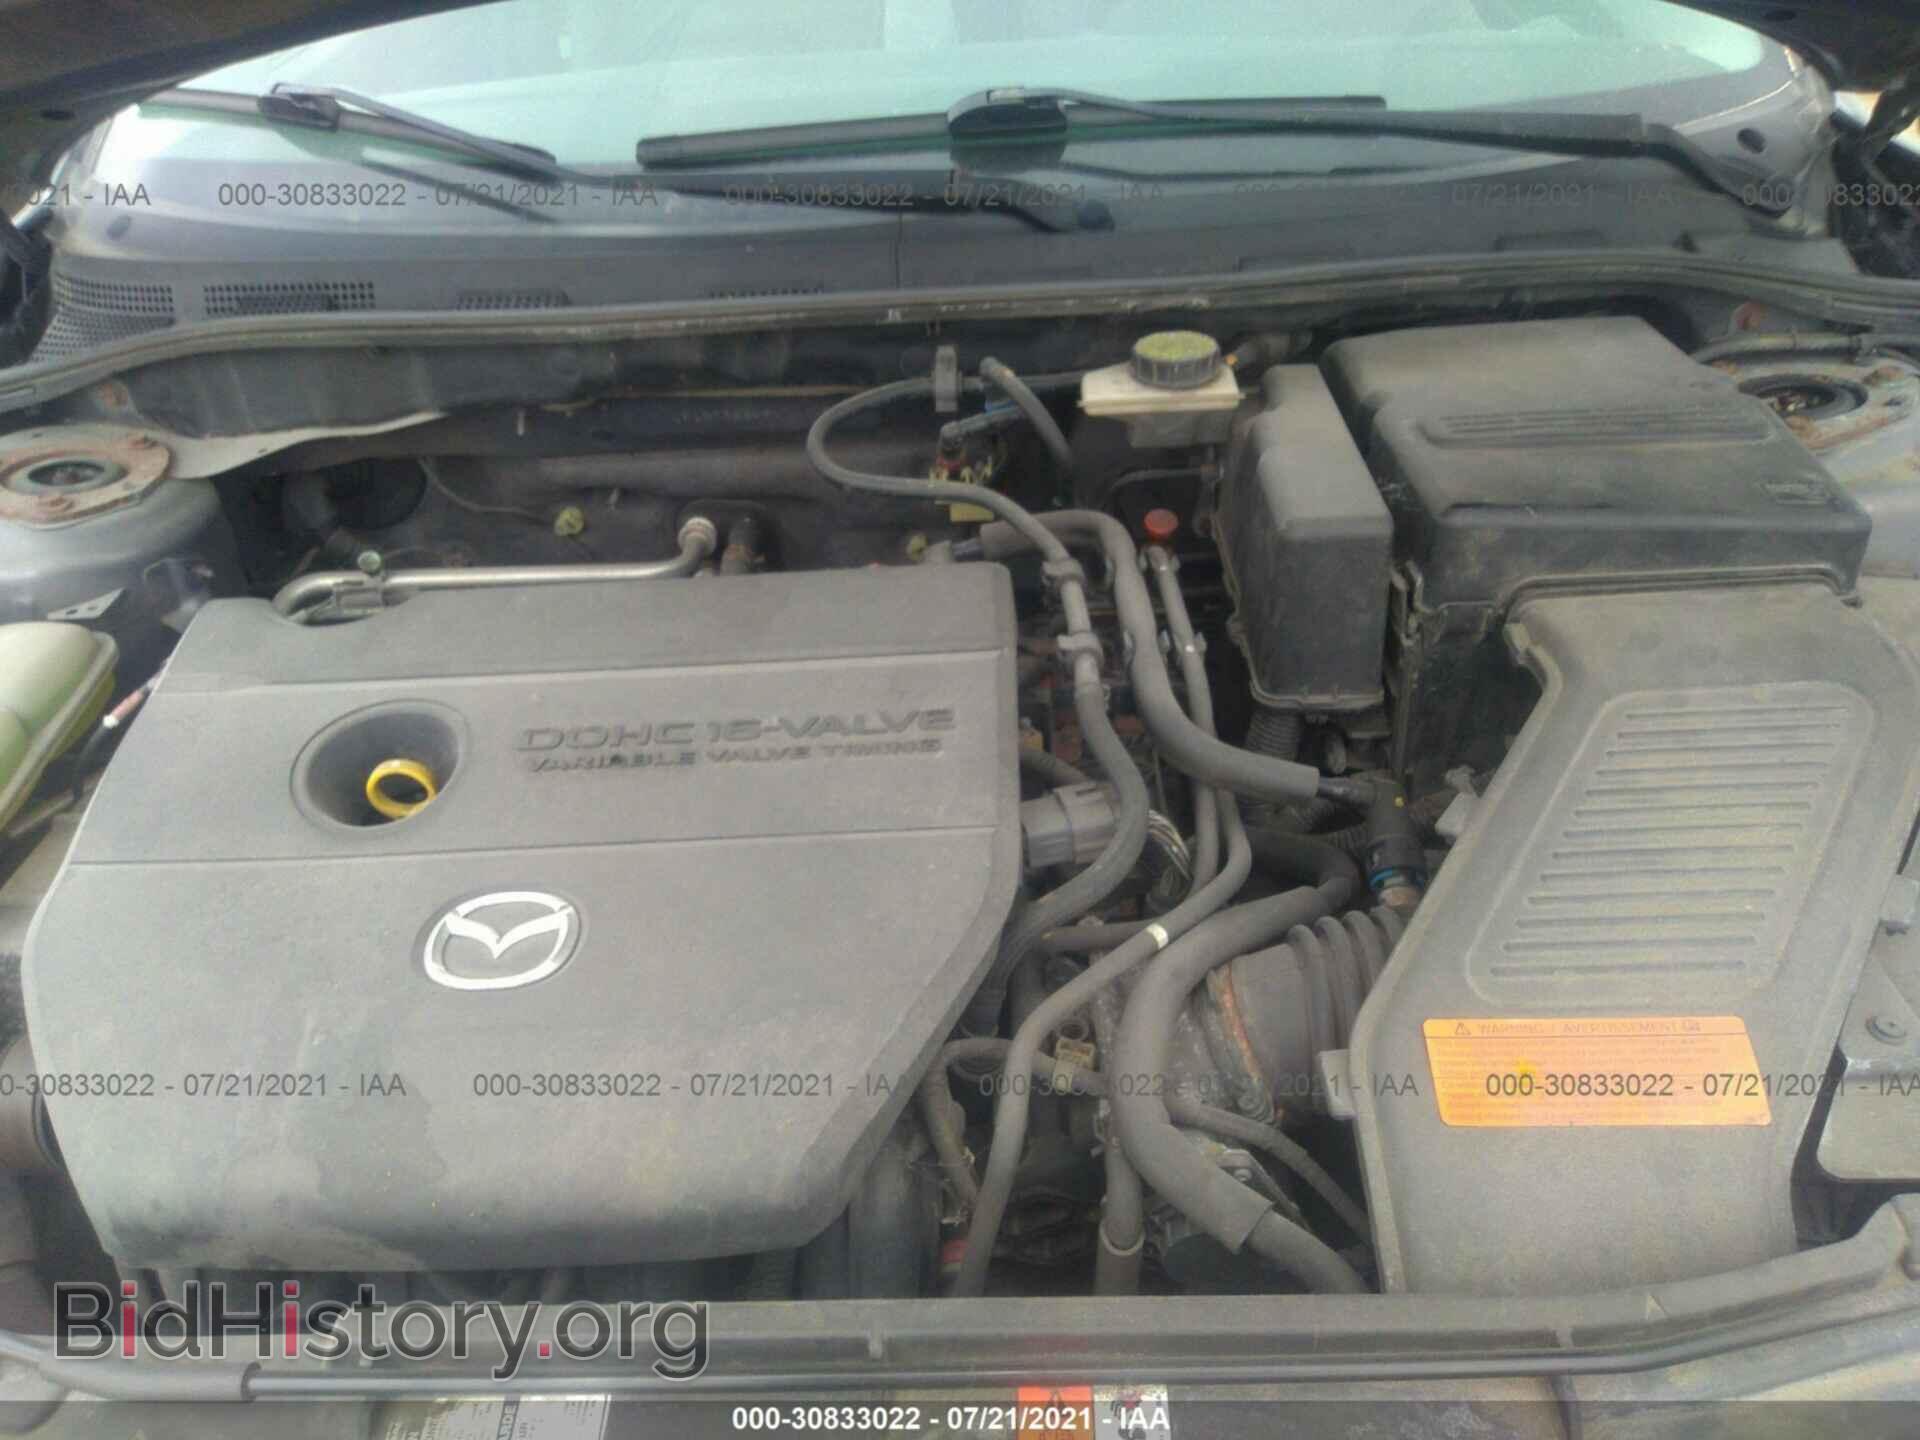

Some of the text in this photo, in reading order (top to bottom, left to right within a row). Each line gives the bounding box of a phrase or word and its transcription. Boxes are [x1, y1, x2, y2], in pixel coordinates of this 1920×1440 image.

[516, 708, 956, 752] DOHC 16-VALVE
[706, 745, 812, 763] VALVE
